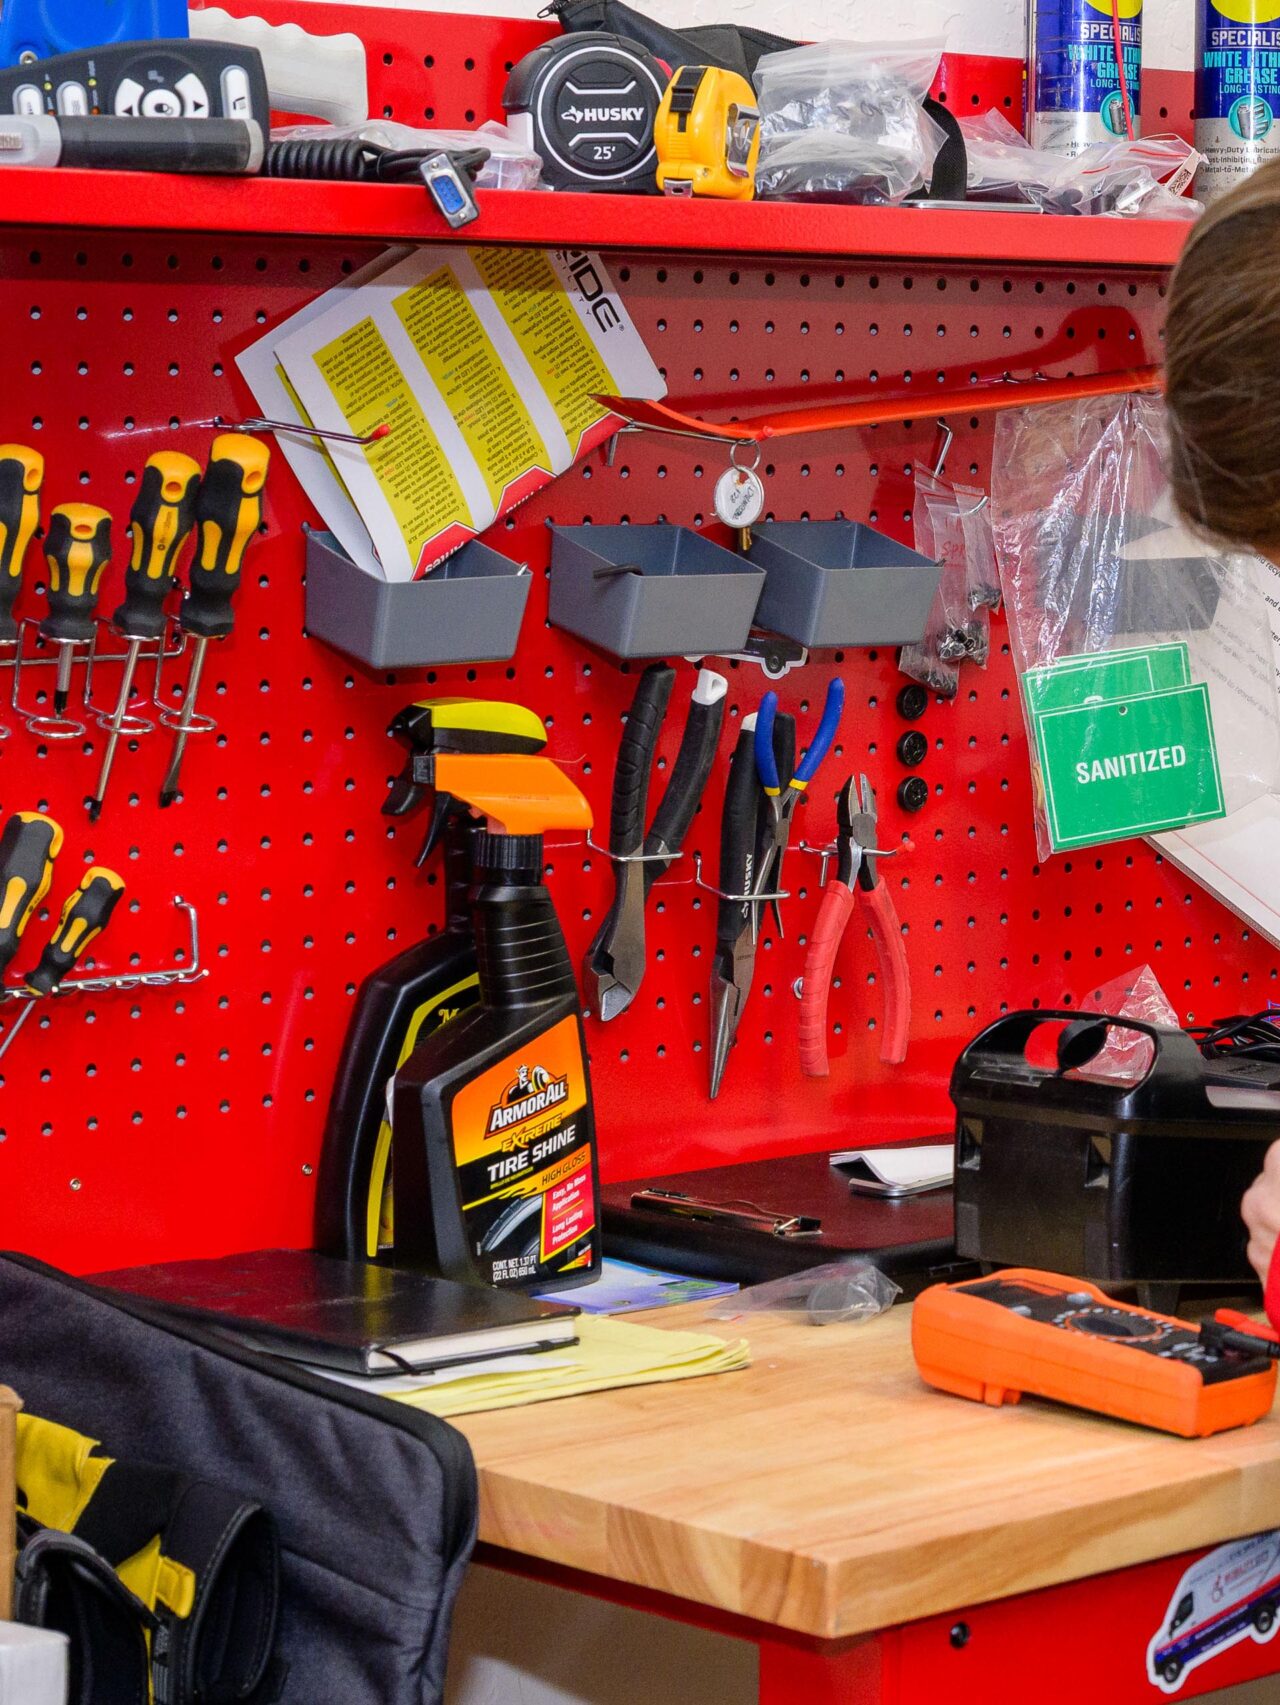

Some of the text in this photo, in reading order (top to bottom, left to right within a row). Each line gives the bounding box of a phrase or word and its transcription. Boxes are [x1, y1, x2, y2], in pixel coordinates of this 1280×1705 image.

[1068, 45, 1114, 62] WHITE
[1204, 51, 1243, 68] WHITE
[1225, 68, 1278, 85] GREASE
[584, 107, 644, 121] HUSKY
[1263, 594, 1279, 608] and
[1075, 745, 1187, 784] SANITIZED
[502, 1113, 564, 1152] EXTREME
[488, 1150, 529, 1182] TIRE
[532, 1125, 576, 1163] SHINE
[542, 1167, 562, 1186] HIGH
[562, 1151, 586, 1178] GLOSS
